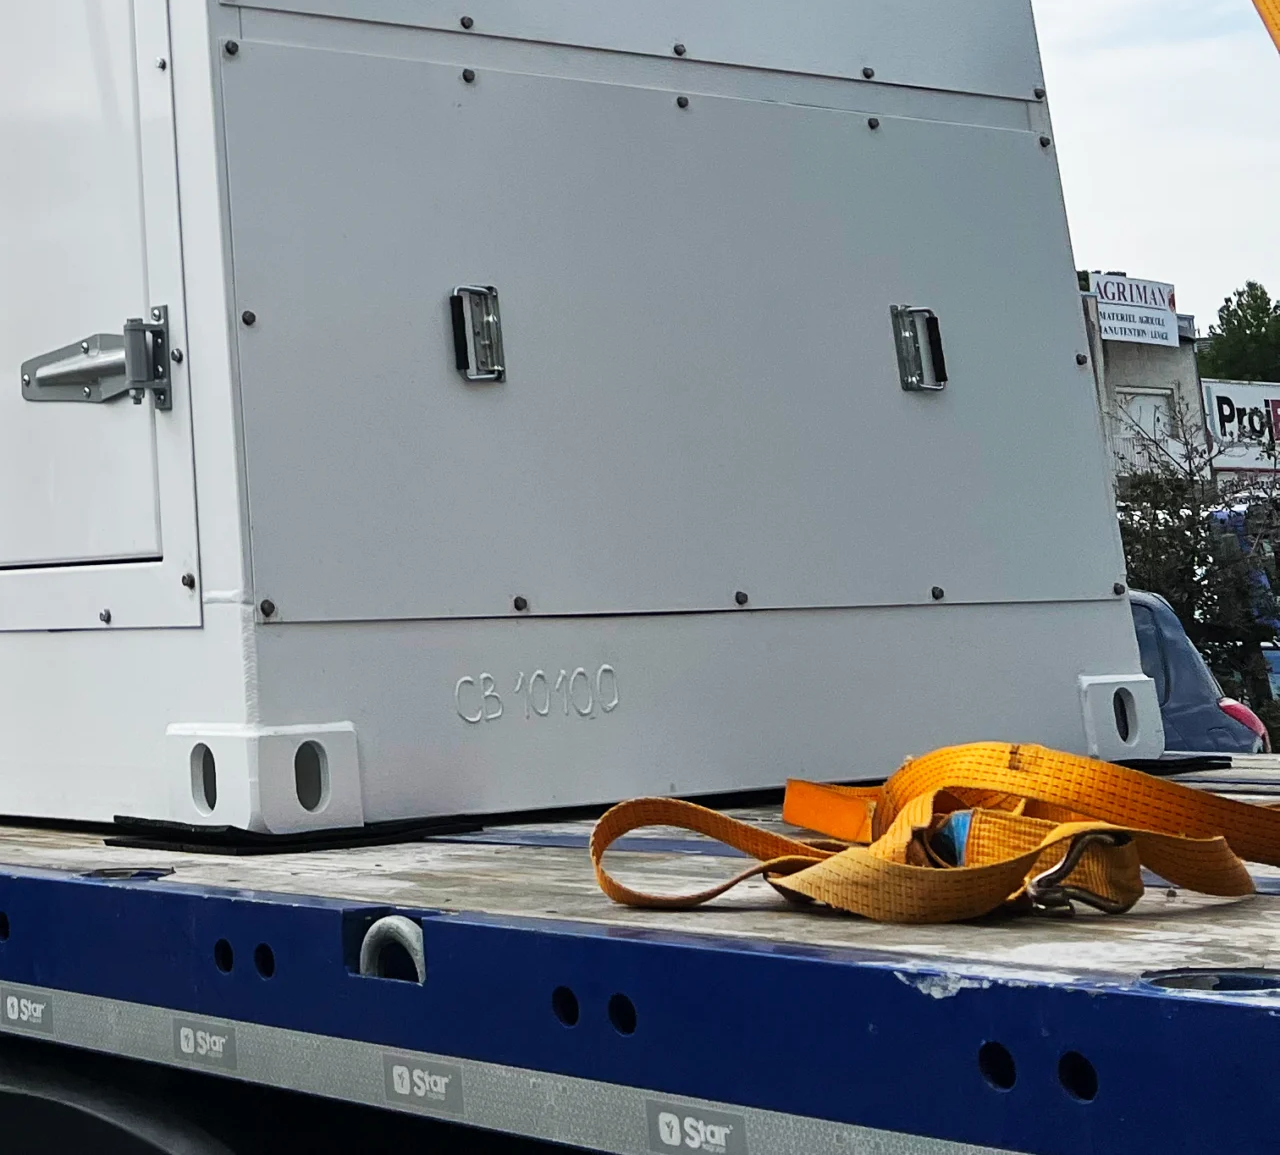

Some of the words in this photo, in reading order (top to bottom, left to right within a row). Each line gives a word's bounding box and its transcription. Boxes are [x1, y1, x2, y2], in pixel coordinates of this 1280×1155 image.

[454, 672, 503, 724] CB
[514, 663, 618, 719] 10100
[20, 998, 45, 1021] Star
[196, 1030, 226, 1056] Star
[412, 1068, 450, 1097] Star
[683, 1116, 731, 1149] Star
